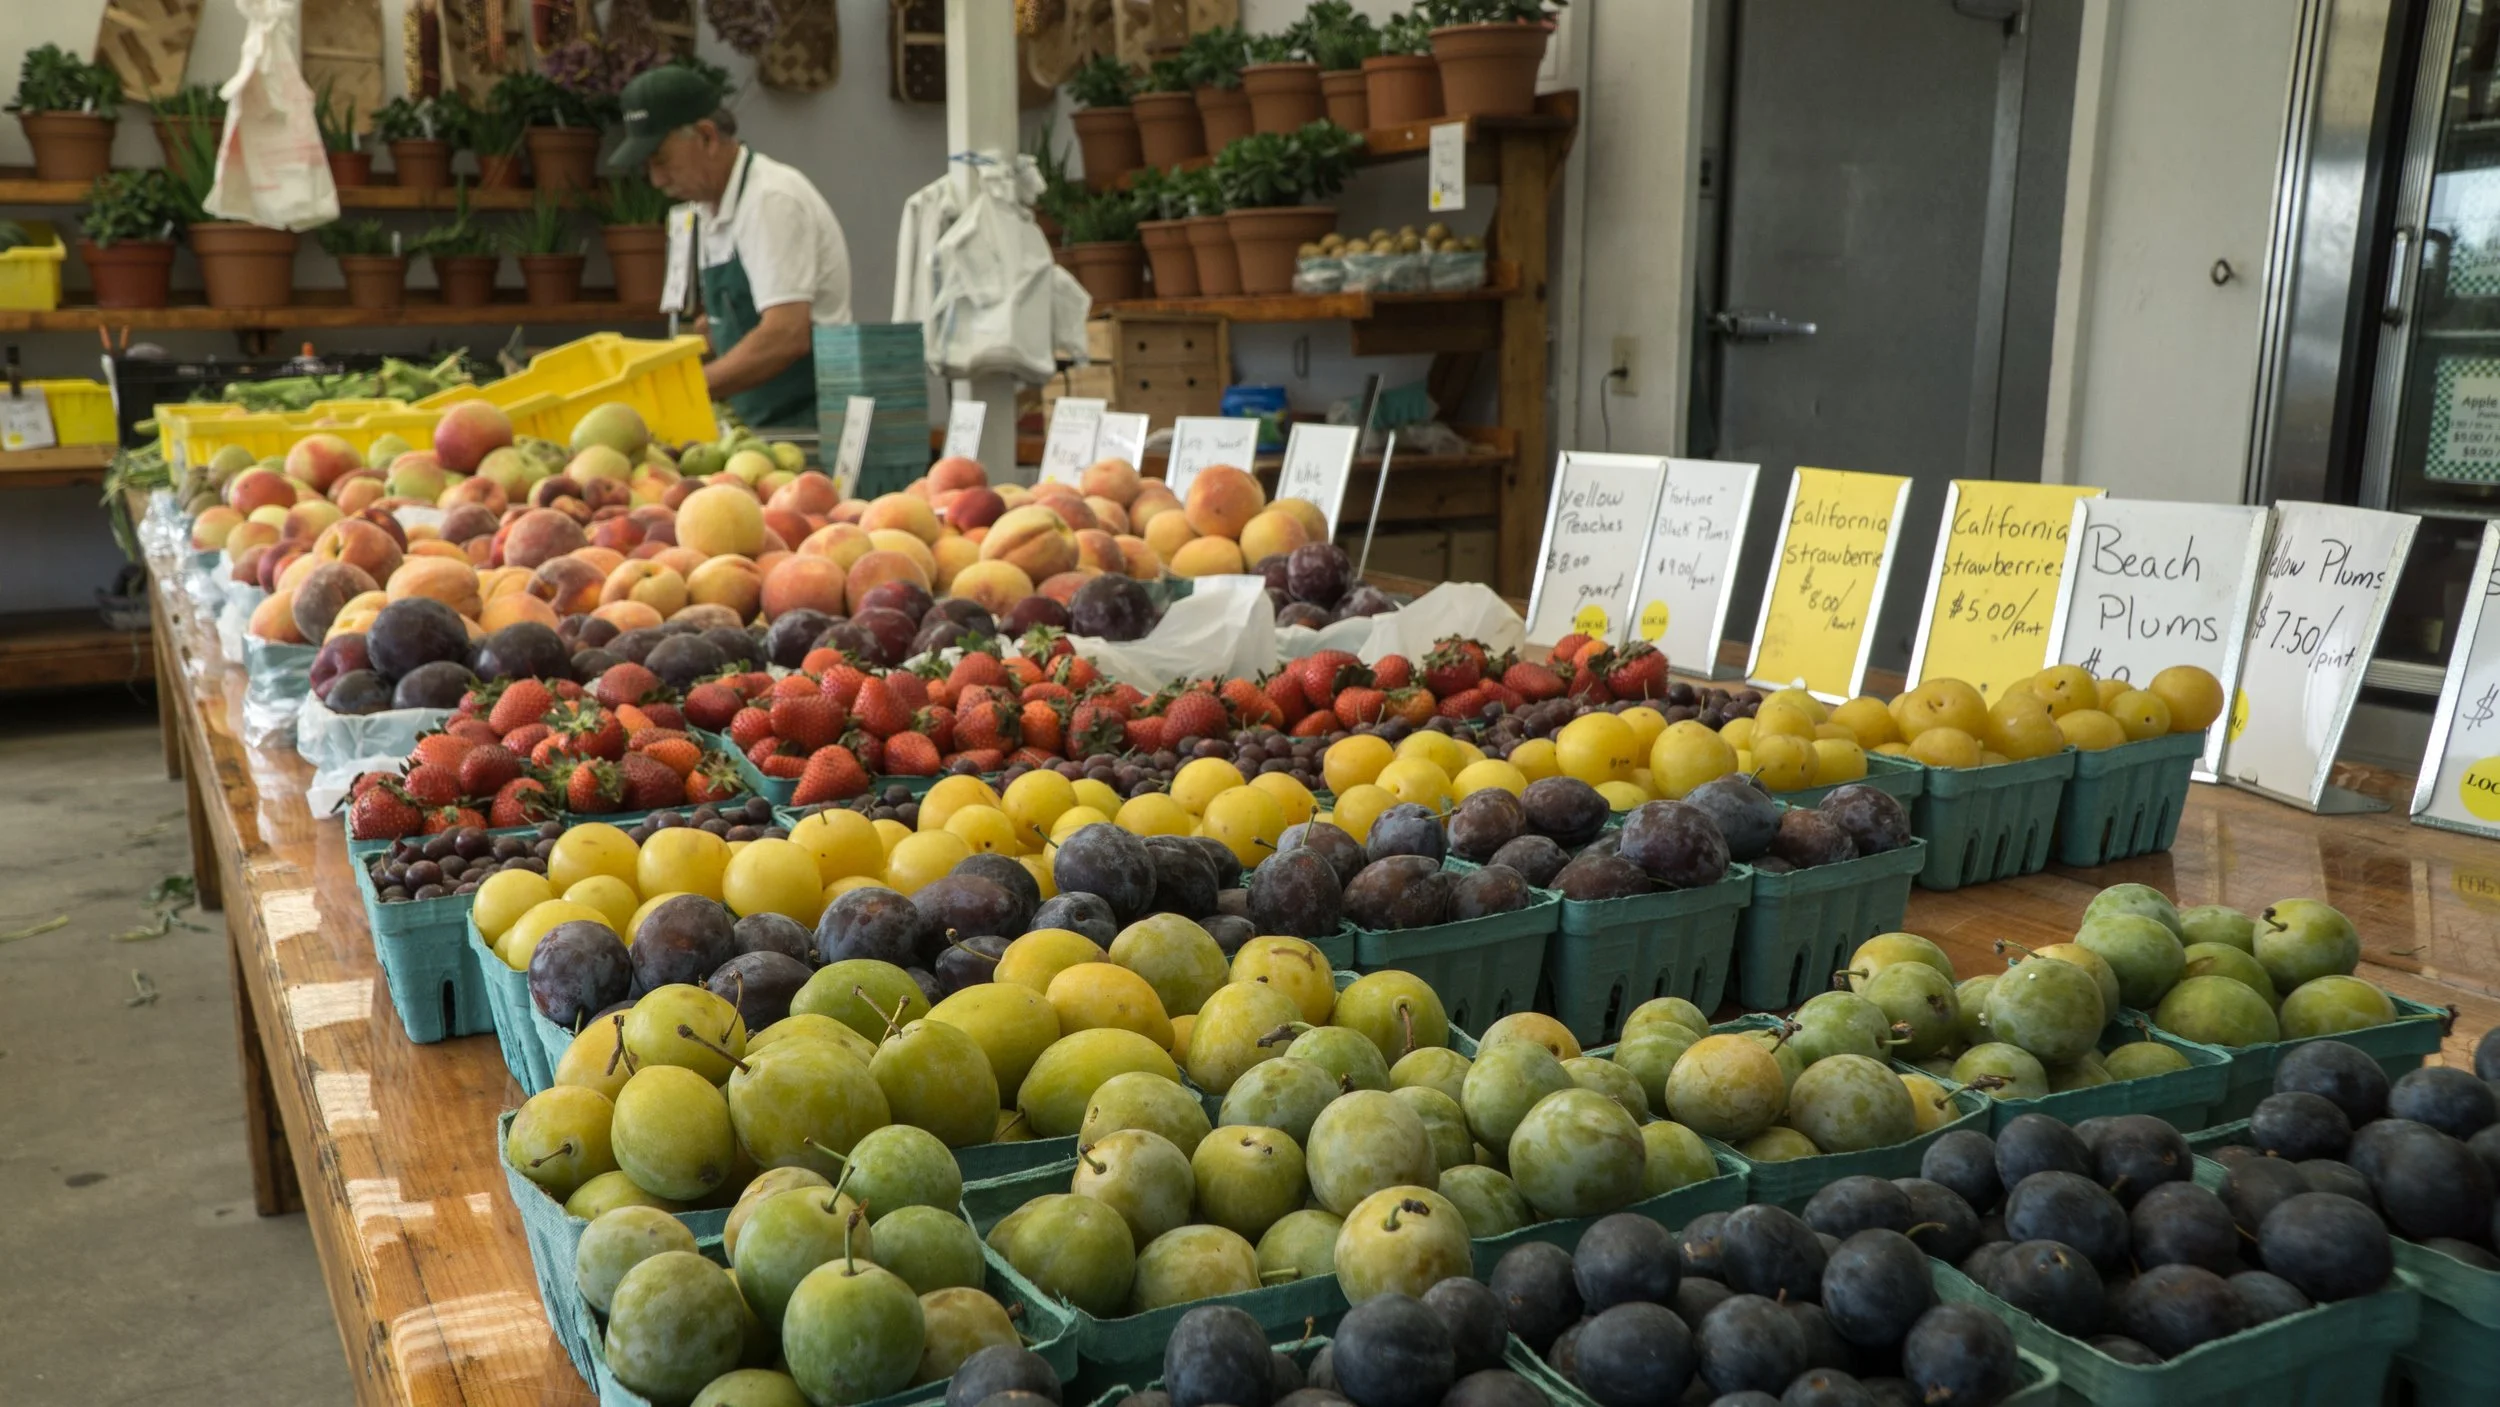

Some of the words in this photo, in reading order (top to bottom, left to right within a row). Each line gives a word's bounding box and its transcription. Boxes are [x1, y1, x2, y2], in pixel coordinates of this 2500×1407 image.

[2461, 394, 2498, 410] Apple
[1561, 511, 1623, 535] Peaches
[1697, 516, 1730, 541] Plums
[1791, 499, 1888, 534] California
[1953, 505, 2068, 544] California
[1786, 542, 1883, 568] Strawberrie
[2088, 524, 2201, 582] Beach
[2318, 538, 2386, 589] Plums
[1576, 619, 1605, 630] LOCAL
[1642, 615, 1668, 626] LOCAL
[2098, 594, 2218, 642] Plums
